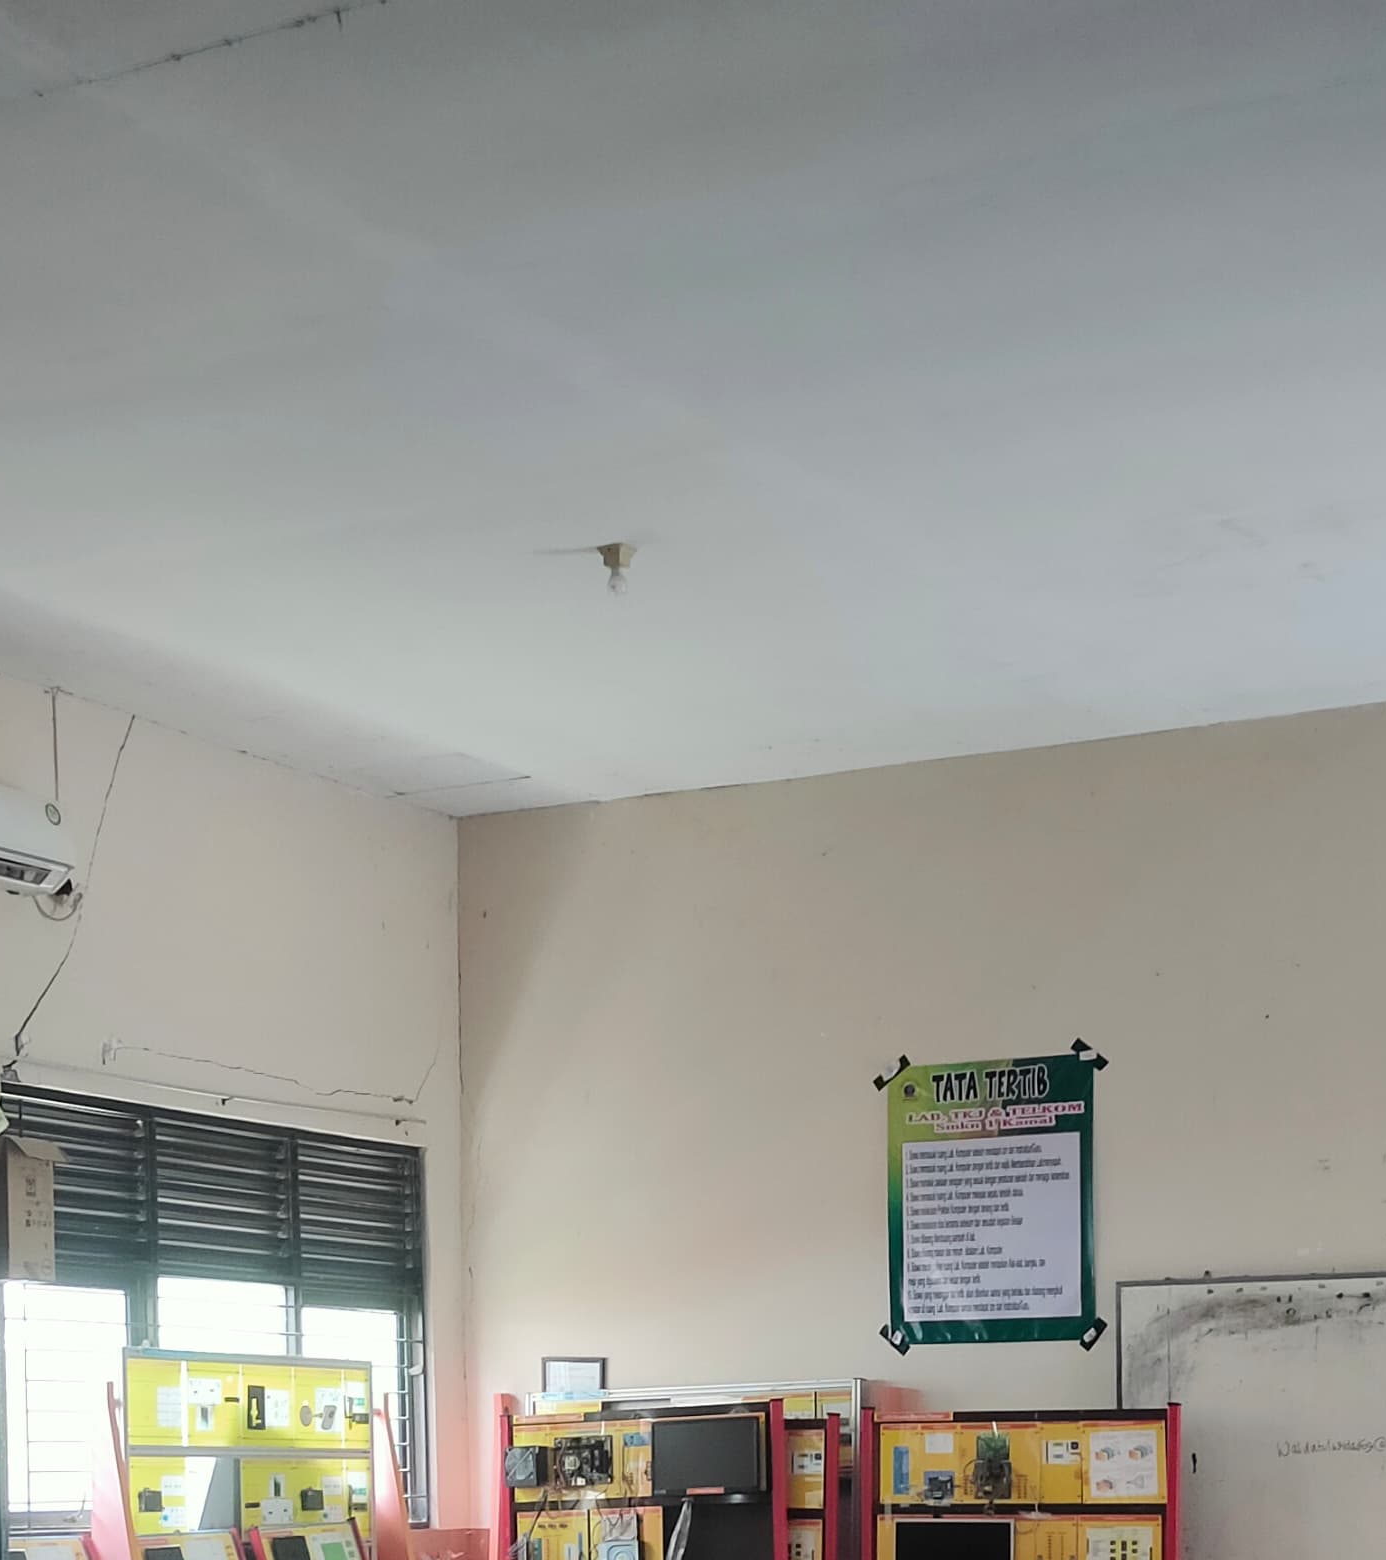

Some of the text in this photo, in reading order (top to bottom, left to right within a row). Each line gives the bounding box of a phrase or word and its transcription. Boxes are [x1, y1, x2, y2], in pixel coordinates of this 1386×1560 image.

[931, 1065, 1049, 1103] TATA TERTIB
[951, 1109, 983, 1119] TKJ
[1008, 1103, 1082, 1115] TELKOM
